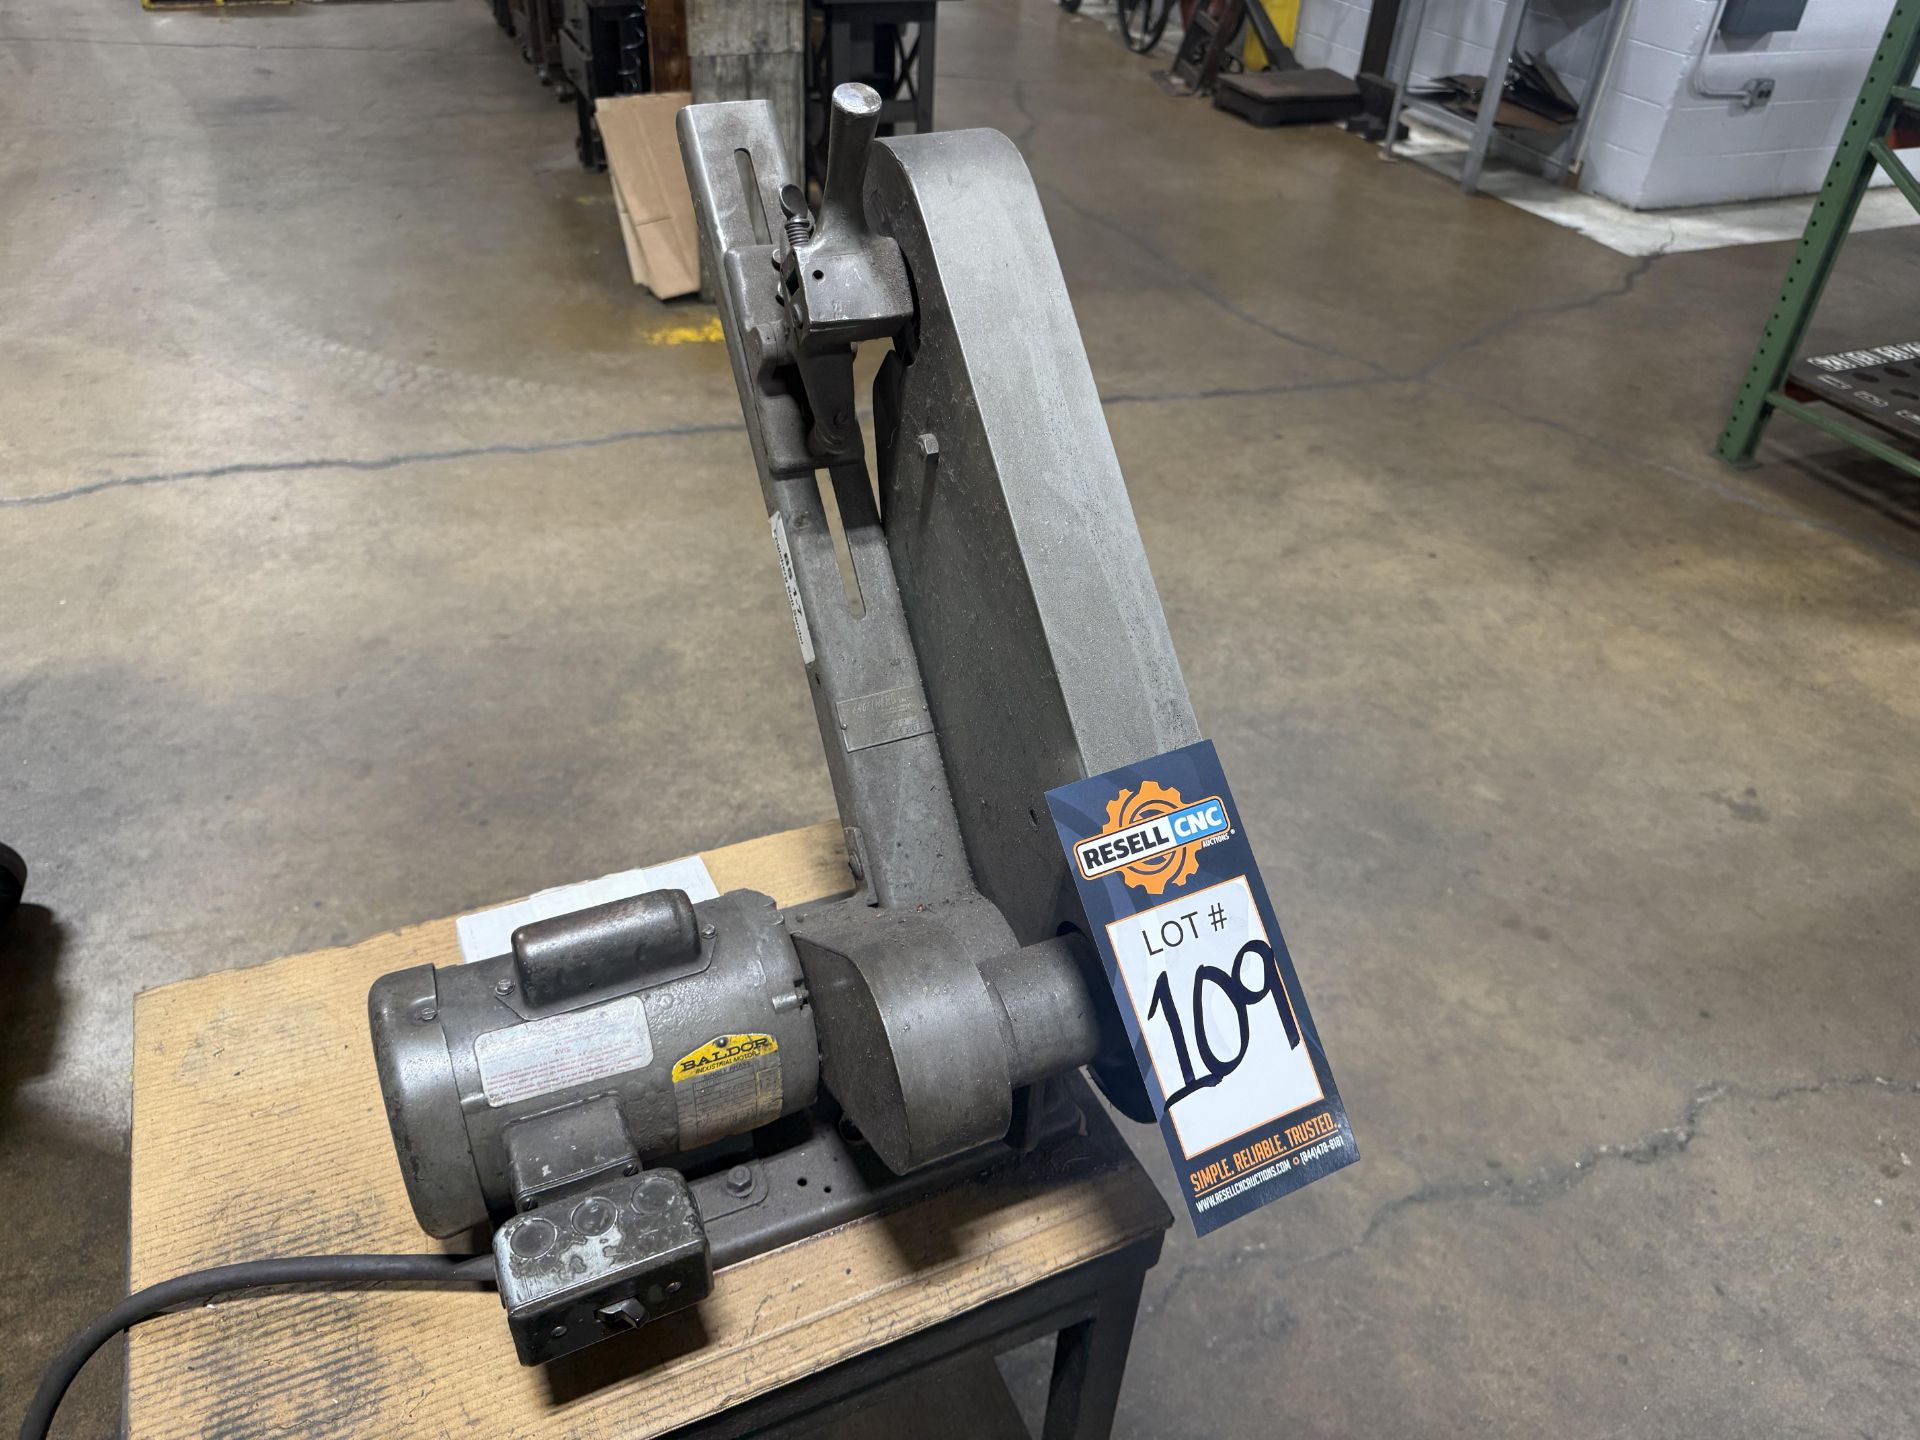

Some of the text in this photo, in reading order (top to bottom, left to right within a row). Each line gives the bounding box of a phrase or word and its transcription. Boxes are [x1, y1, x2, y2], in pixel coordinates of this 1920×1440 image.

[1082, 806, 1223, 870] RESELL CNC
[1202, 832, 1230, 849] AUCTIONS
[1141, 902, 1228, 956] LOT #
[1147, 939, 1300, 1112] 109
[680, 1037, 769, 1072] BALDOR
[695, 1058, 733, 1075] INDUSTRIAL
[1190, 1112, 1338, 1192] SIMPLE. RELIABLE. TRUSTED.
